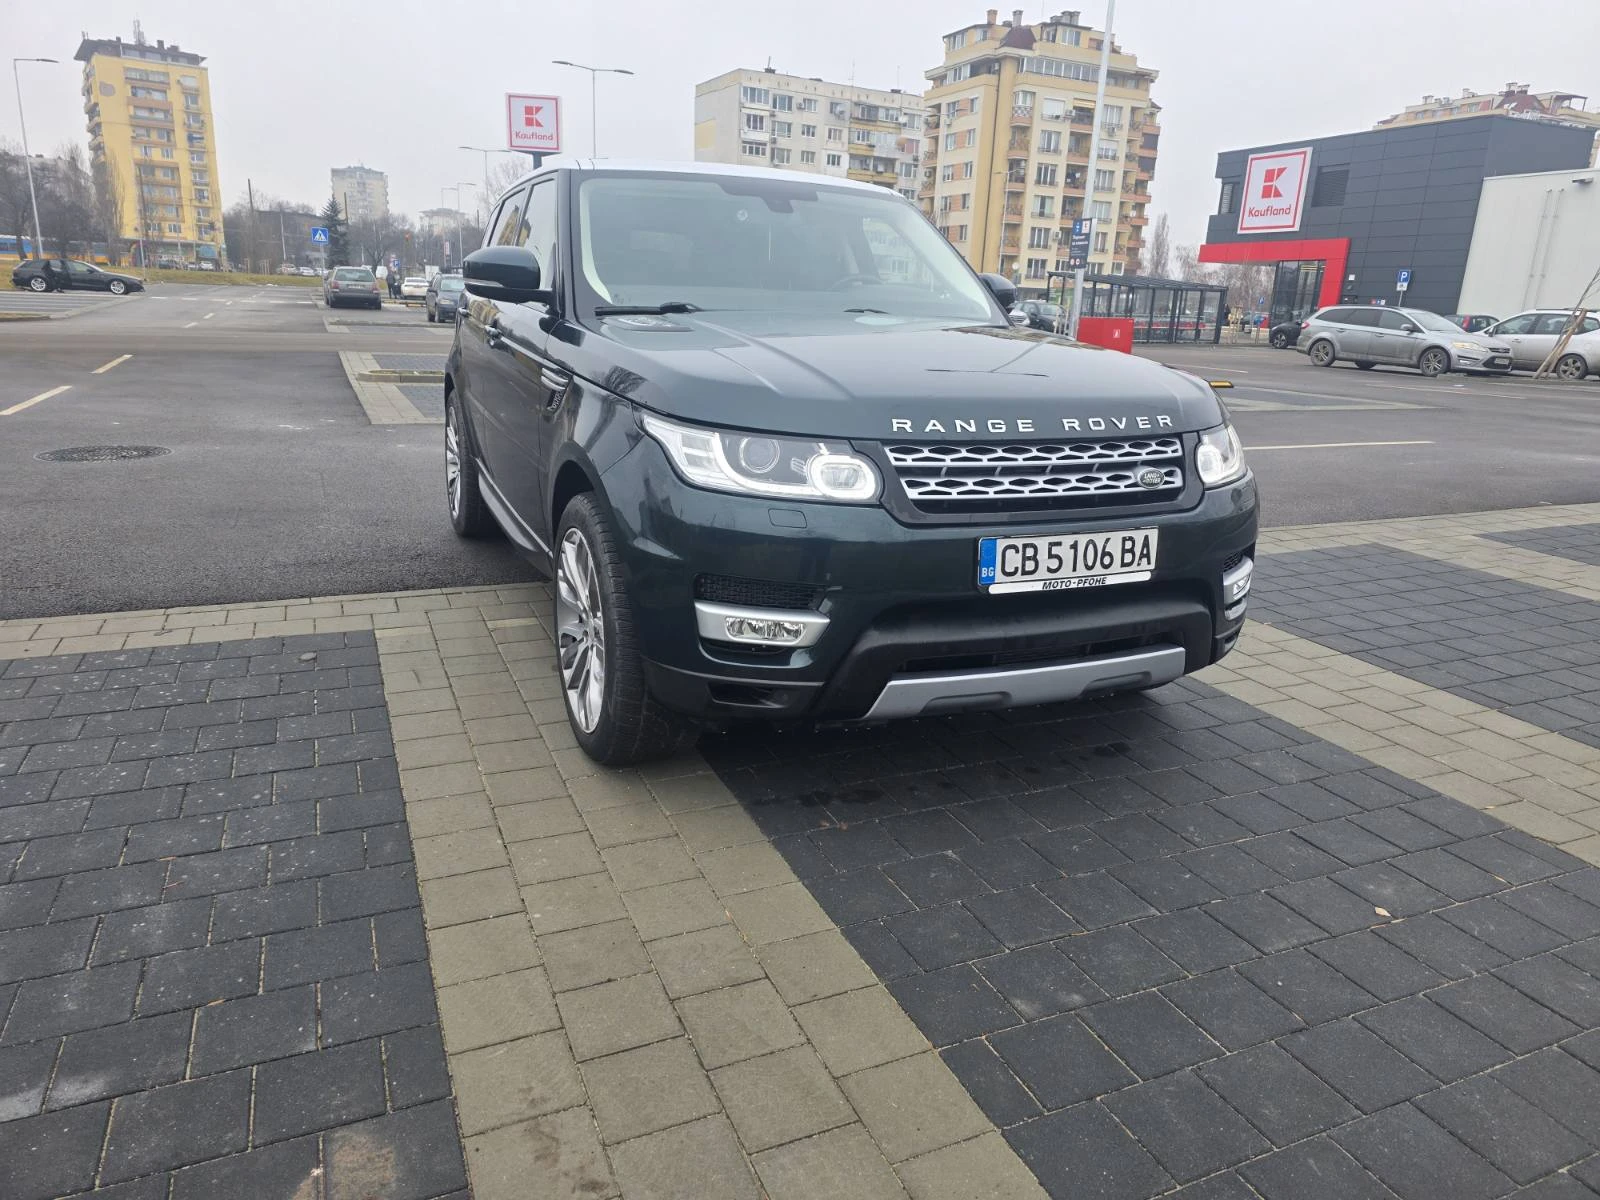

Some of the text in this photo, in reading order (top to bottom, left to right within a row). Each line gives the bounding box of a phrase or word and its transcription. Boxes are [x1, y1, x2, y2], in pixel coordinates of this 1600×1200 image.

[515, 130, 554, 141] Kaufland
[1248, 204, 1291, 218] Kaufland
[1401, 271, 1408, 282] P
[891, 415, 1173, 433] RANGE ROVER
[981, 567, 994, 577] BG
